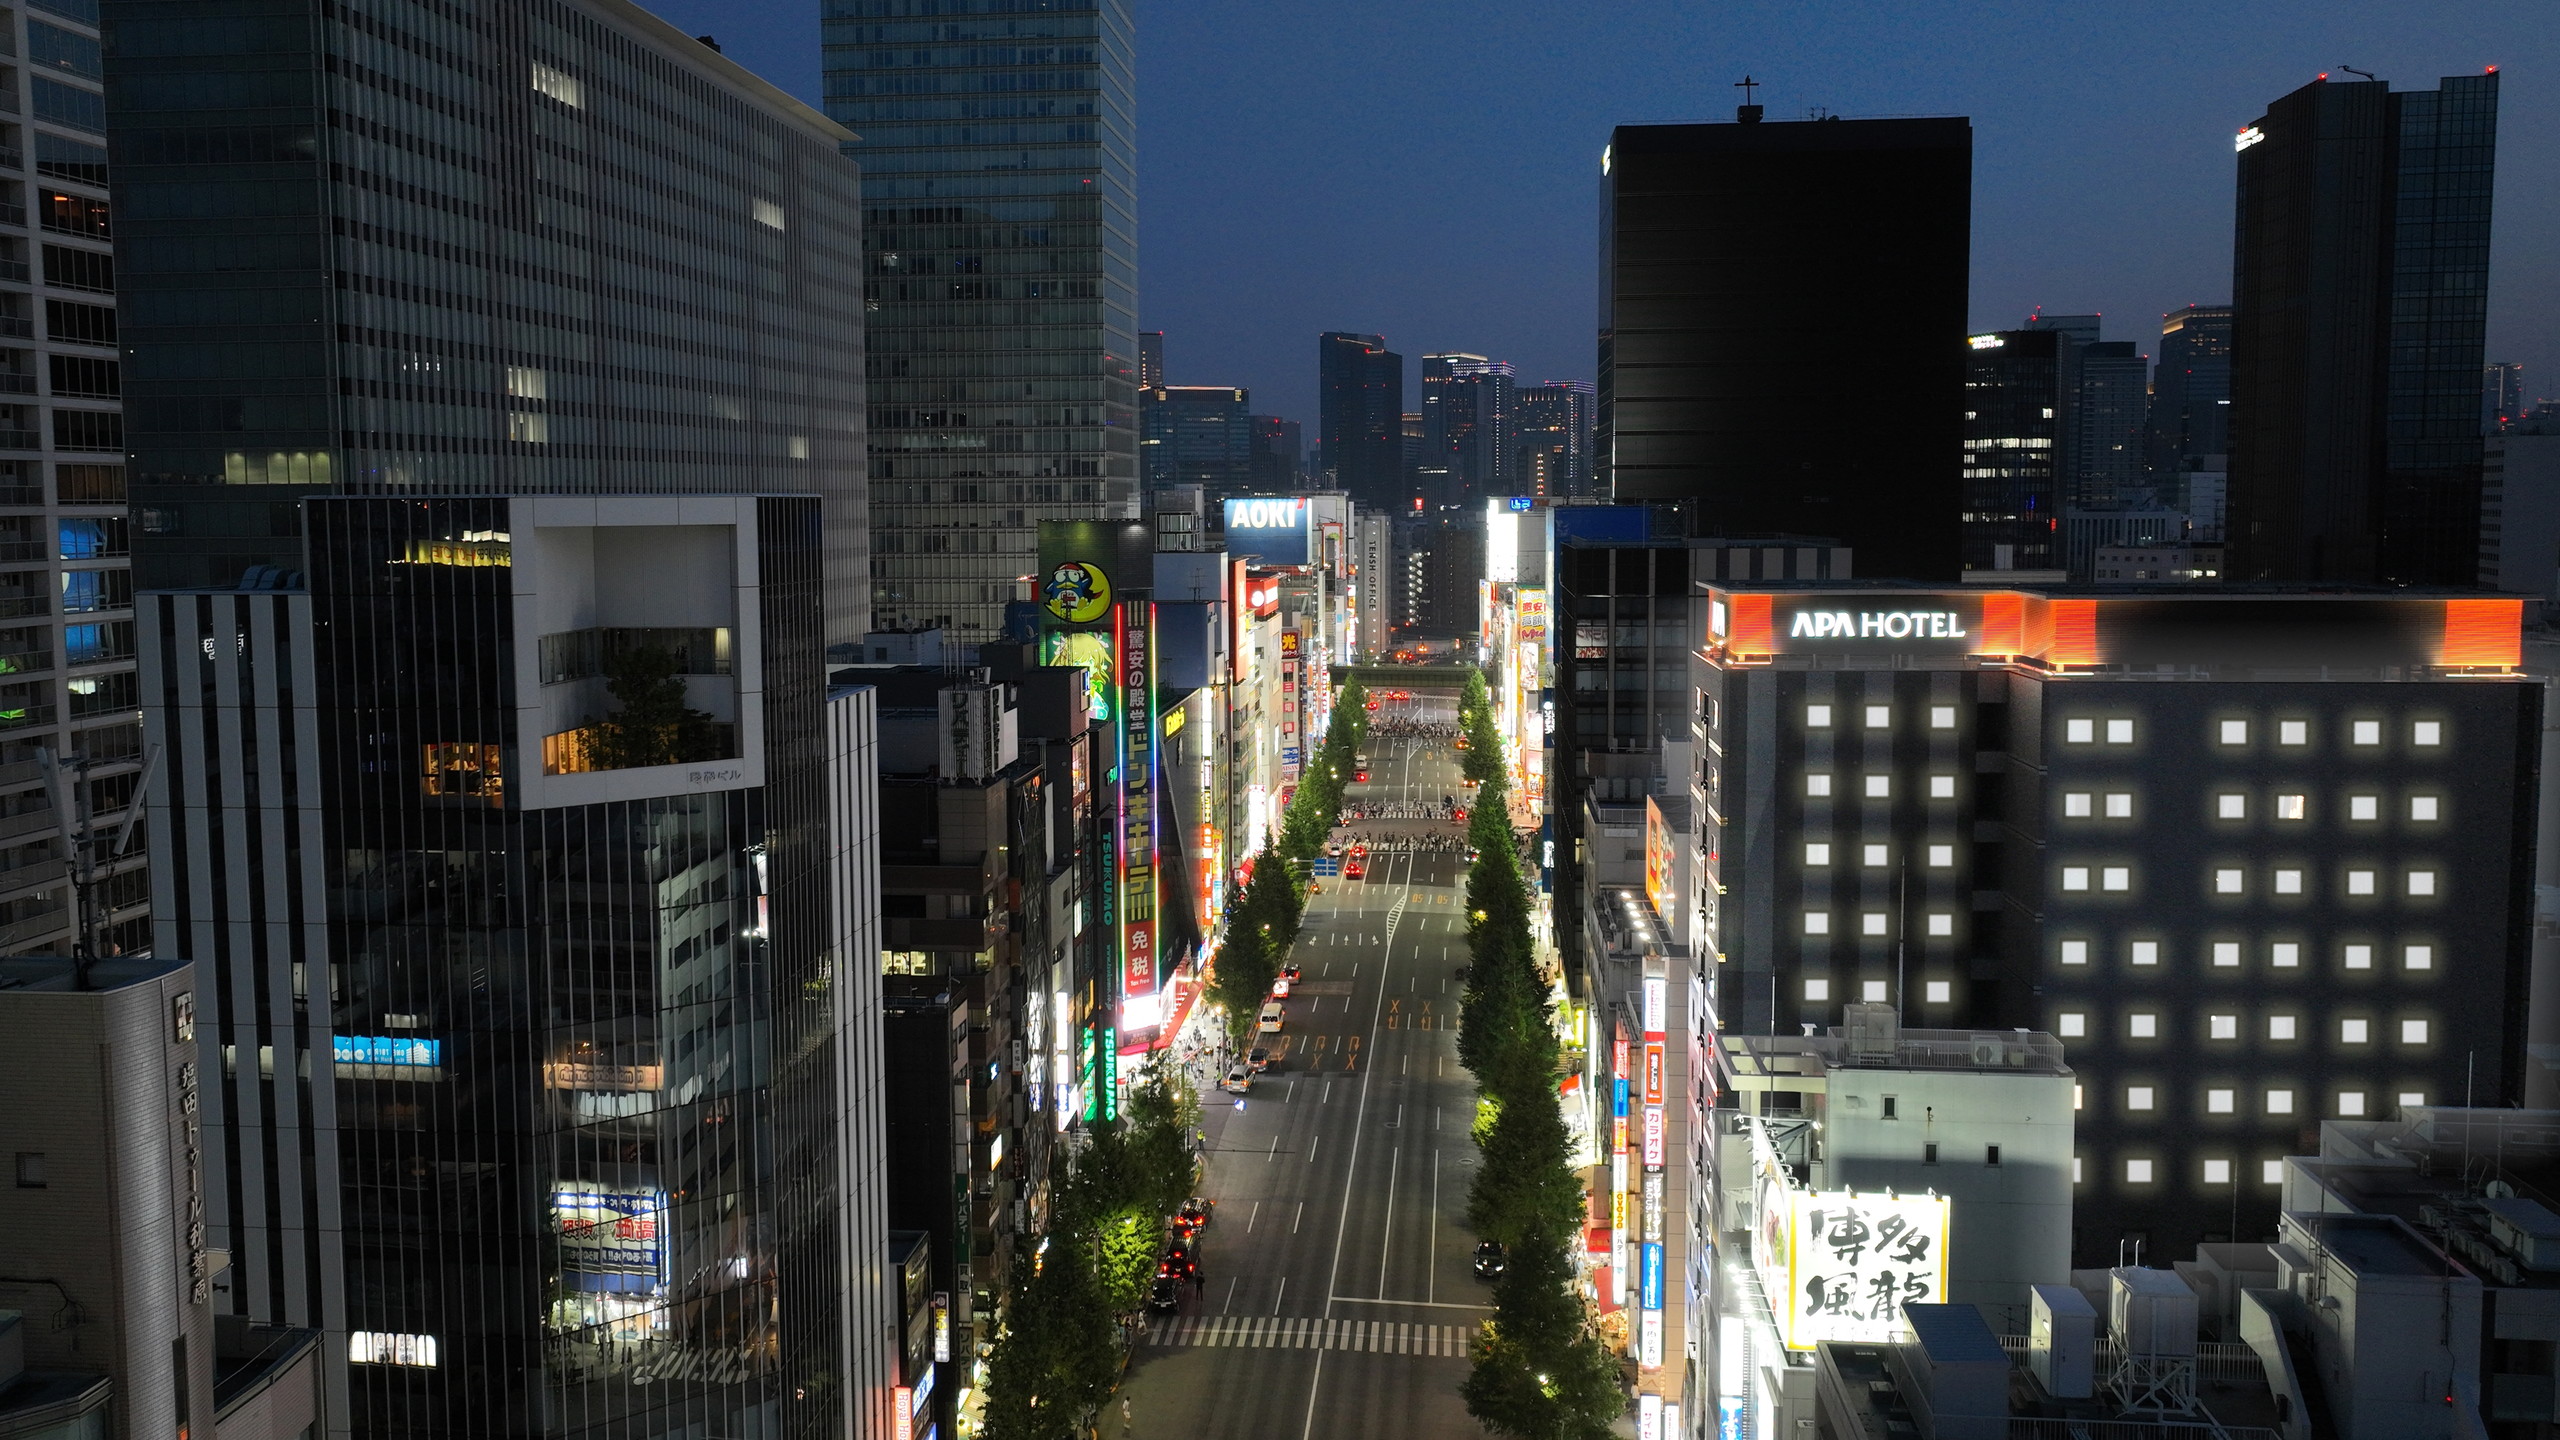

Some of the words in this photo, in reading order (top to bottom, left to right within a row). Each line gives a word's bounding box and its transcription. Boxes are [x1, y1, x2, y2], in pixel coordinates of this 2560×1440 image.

[1231, 500, 1297, 528] AOKI
[1368, 577, 1377, 610] OFFICE
[1791, 612, 1856, 638] APA
[1861, 612, 1966, 638] HOTEL
[1128, 630, 1146, 730] 驚安の殿堂
[1103, 832, 1113, 925] TSUKUMO
[1105, 945, 1114, 1011] www.tsukumo.co.jp
[1131, 931, 1148, 977] 免税
[1651, 982, 1661, 1031] SUSHIRO
[1103, 1028, 1116, 1121] TSUKUMO
[1649, 1113, 1660, 1159] カラオケ
[183, 1063, 208, 1306] 塩田トゥール秋葉原
[958, 1192, 968, 1244] リバティー
[1809, 1206, 1931, 1267] 博多
[959, 1265, 969, 1291] 買取
[1805, 1270, 1933, 1322] 風龍
[960, 1332, 971, 1385] リバティー
[897, 1393, 909, 1420] Royal
[899, 1425, 909, 1440] Ho
